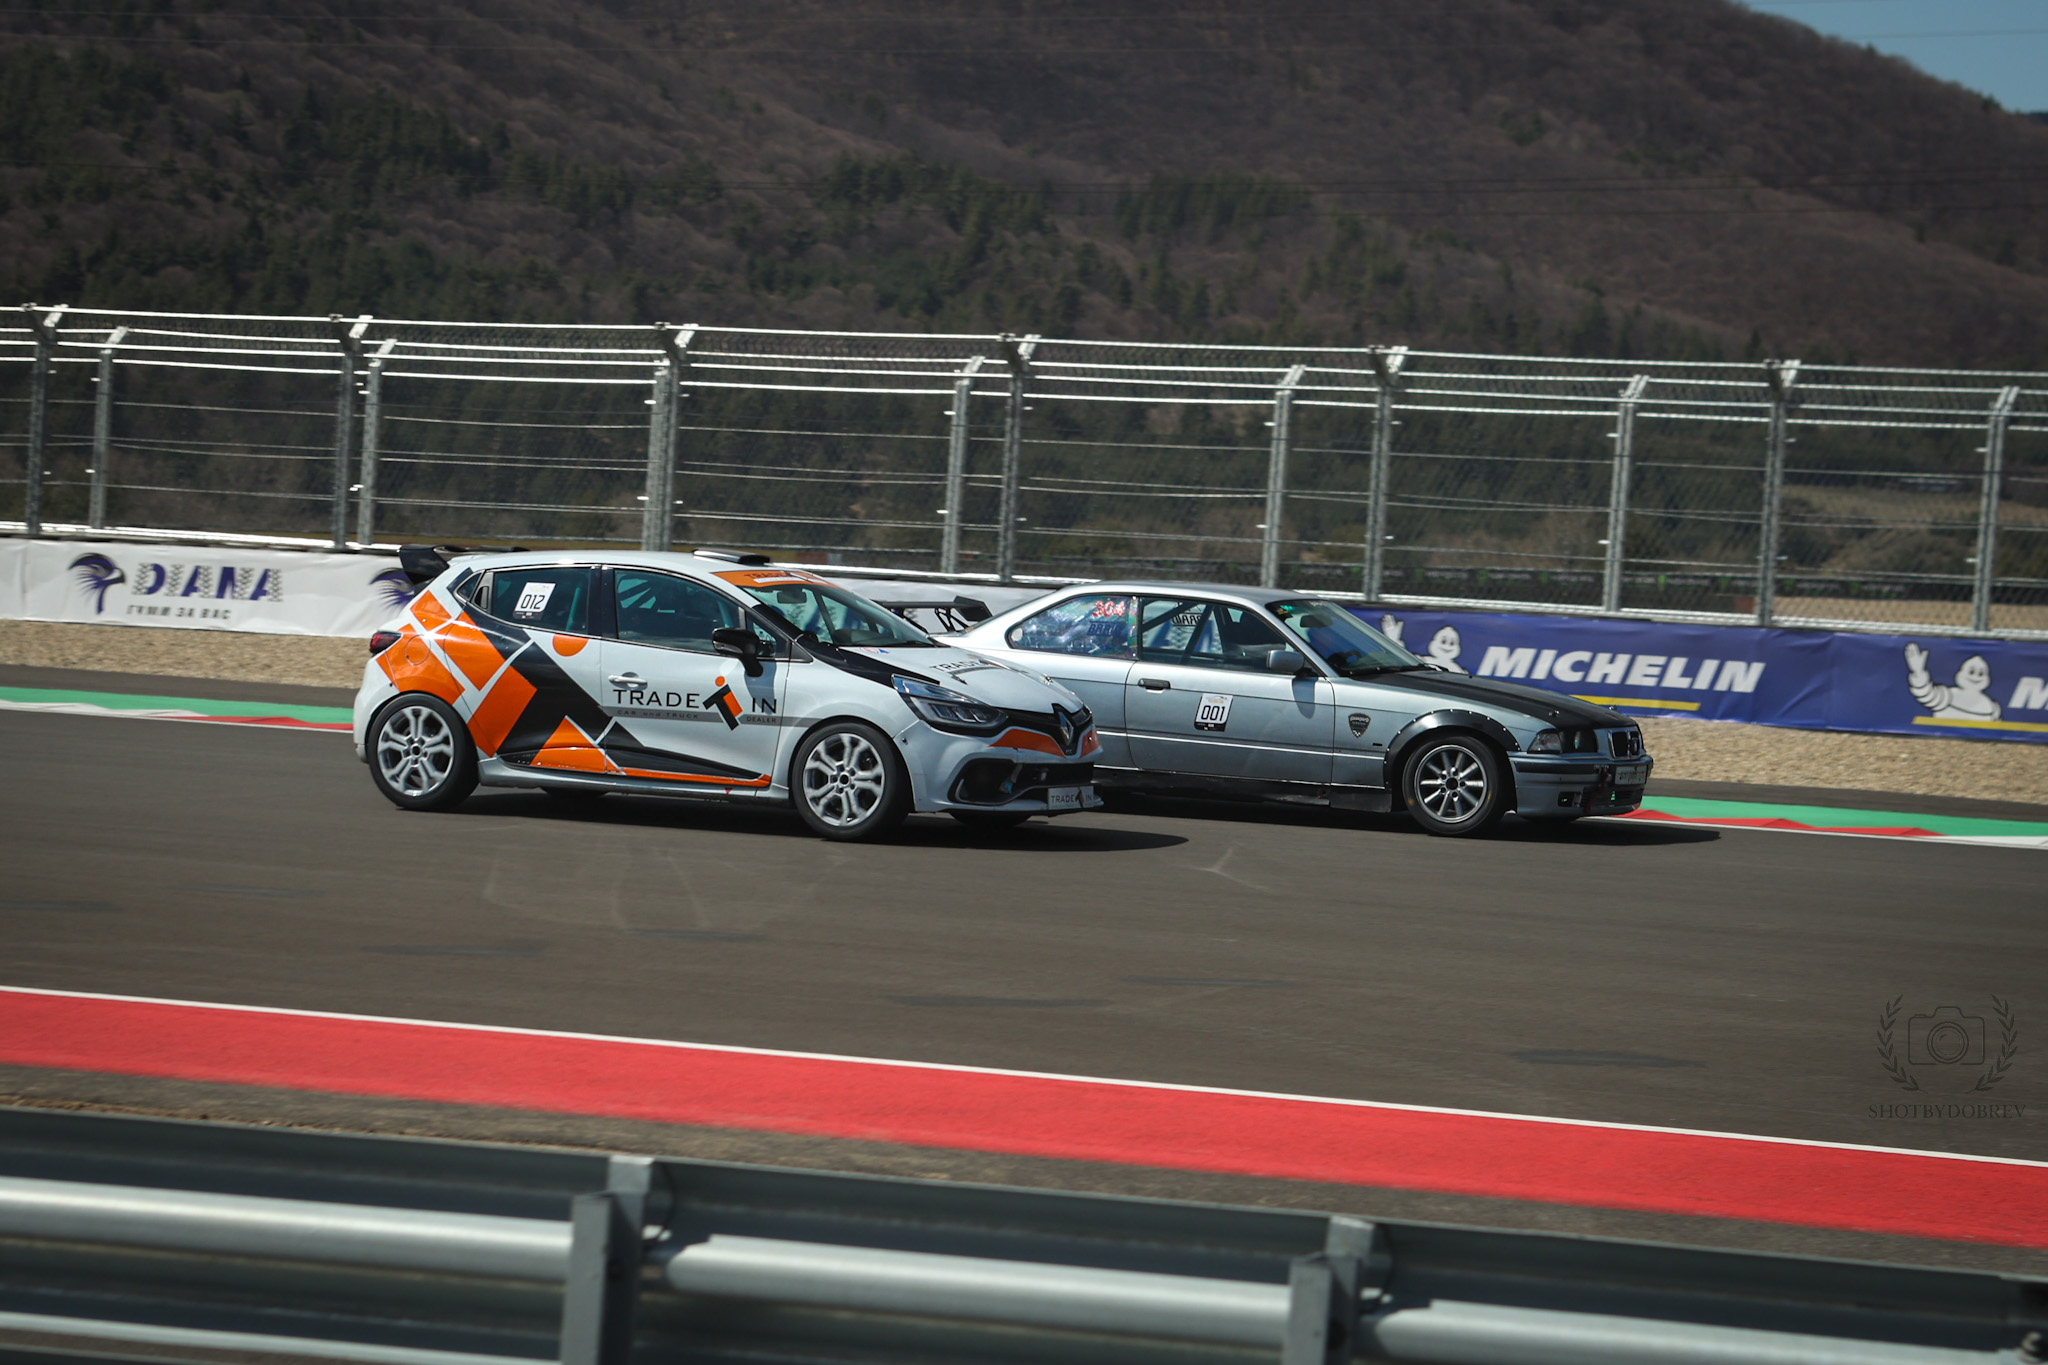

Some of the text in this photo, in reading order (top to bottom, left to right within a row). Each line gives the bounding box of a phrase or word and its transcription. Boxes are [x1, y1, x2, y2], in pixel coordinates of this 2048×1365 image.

[132, 562, 283, 602] DIANA
[520, 594, 545, 609] 012
[1092, 600, 1126, 618] 304
[1476, 646, 1766, 694] MICHELIN
[612, 689, 777, 713] TRADE IN
[666, 711, 699, 719] TRUCK
[1201, 705, 1225, 721] 001
[1051, 794, 1075, 804] TRADE
